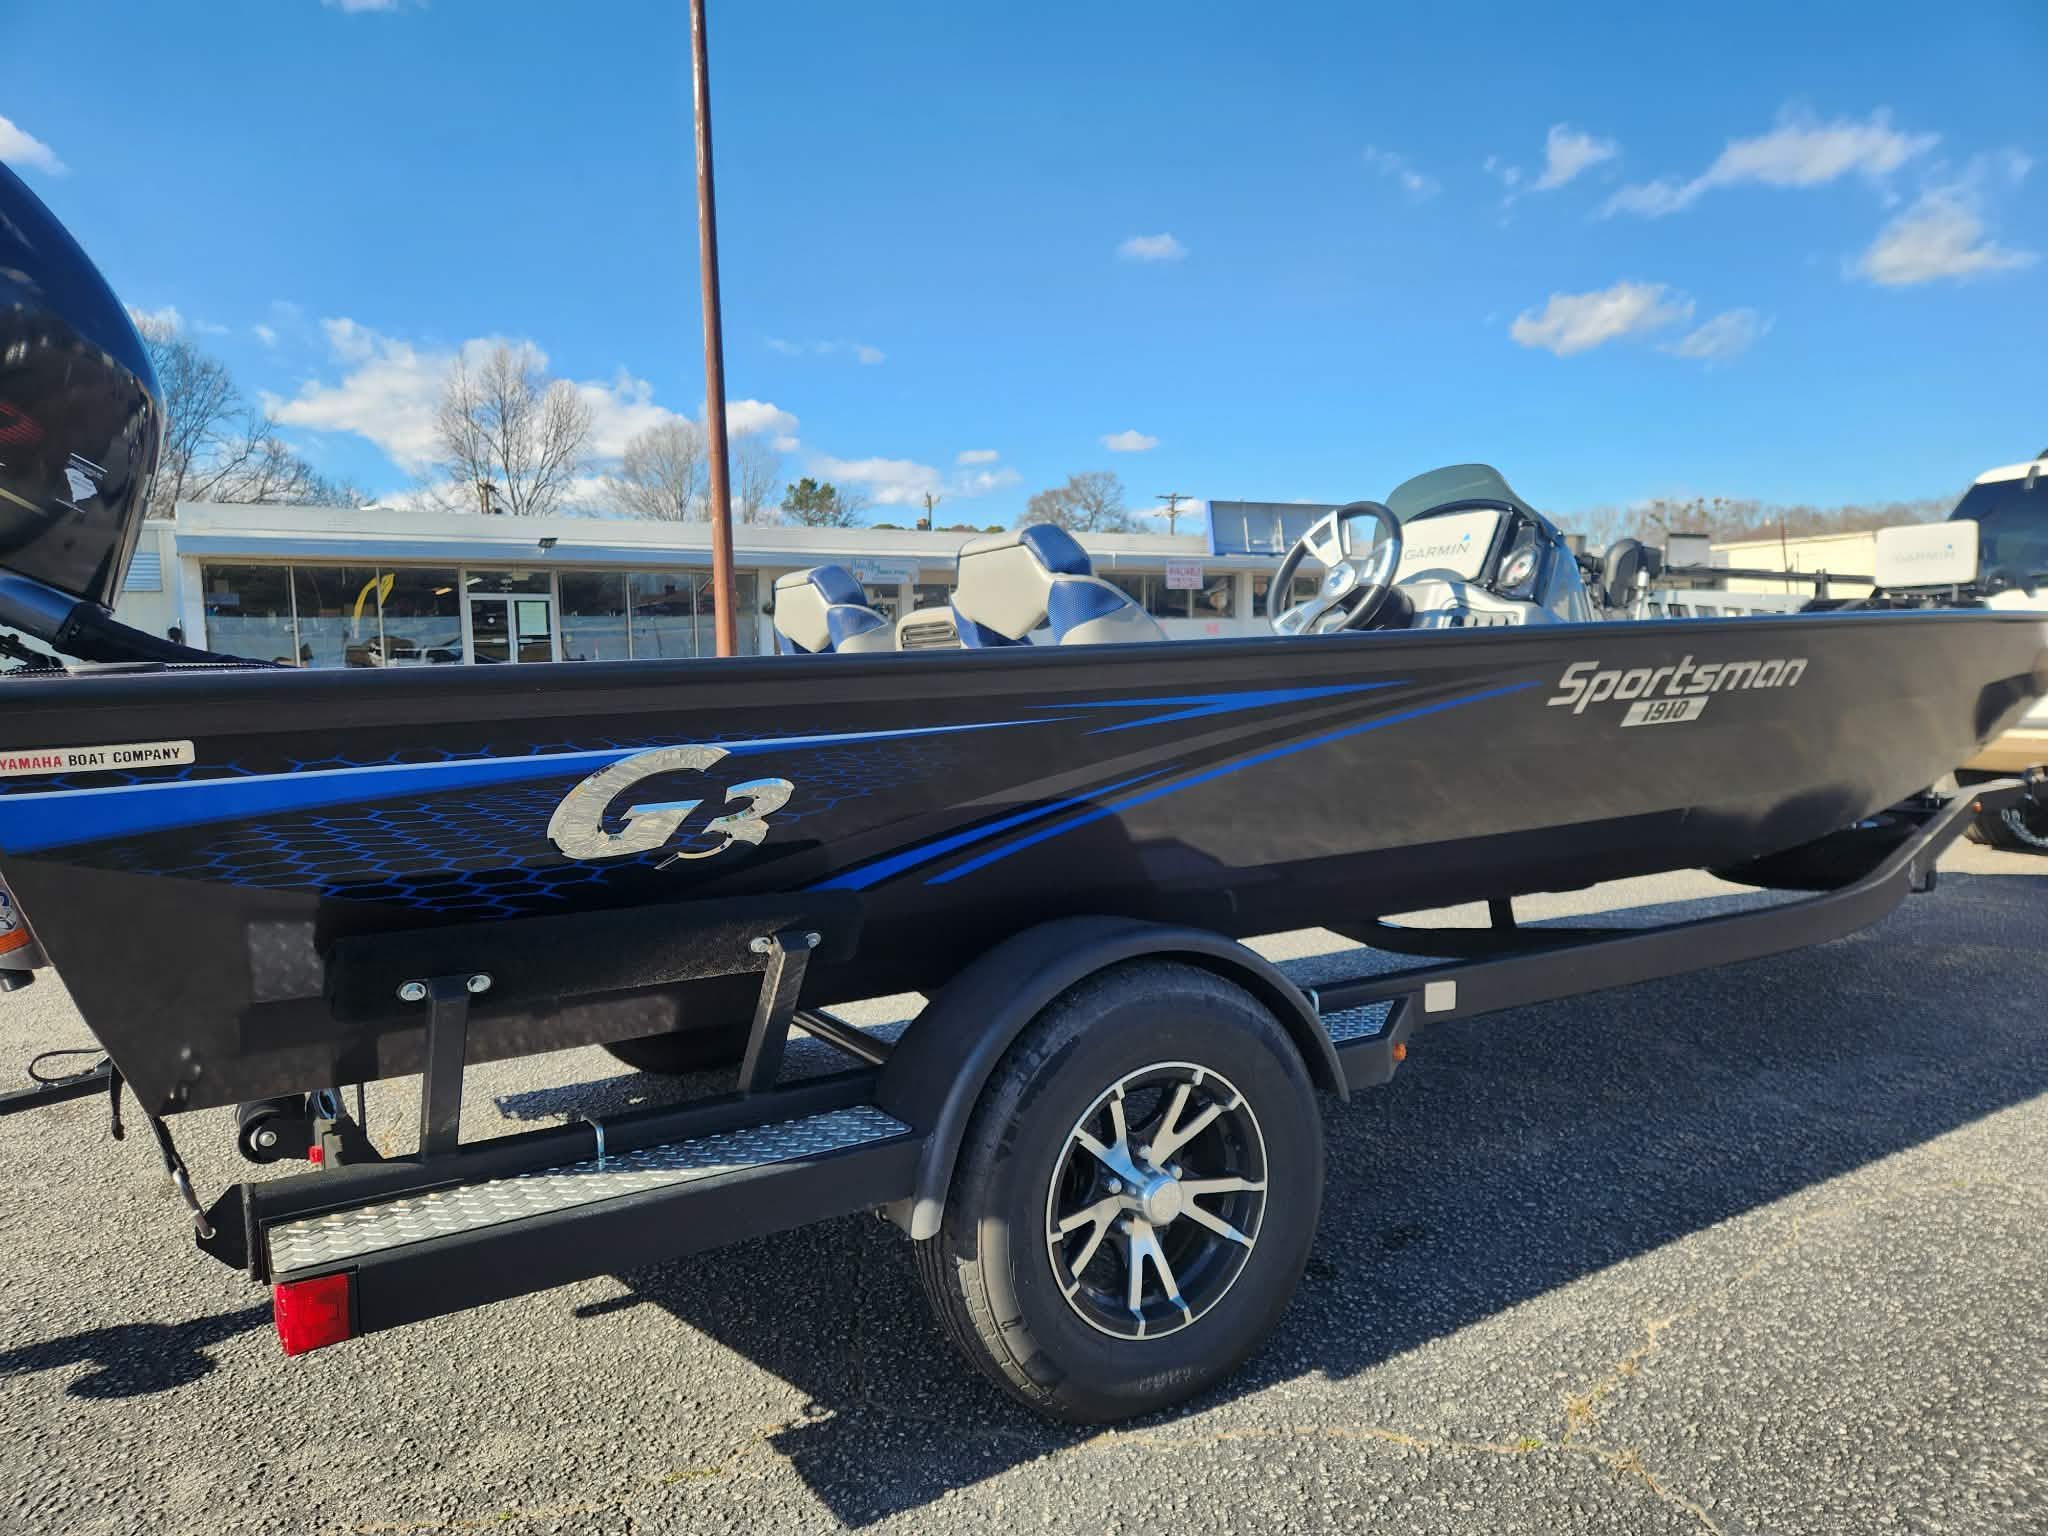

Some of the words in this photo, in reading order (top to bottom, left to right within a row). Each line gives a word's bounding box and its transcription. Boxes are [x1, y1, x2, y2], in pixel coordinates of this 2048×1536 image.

[1404, 543, 1471, 560] GARMIN
[1547, 655, 1809, 714] Sportsman
[1642, 700, 1690, 723] 1910
[0, 755, 63, 770] YAMAHA
[68, 752, 106, 766] BOAT
[113, 747, 181, 763] COMPANY
[547, 743, 796, 870] G3
